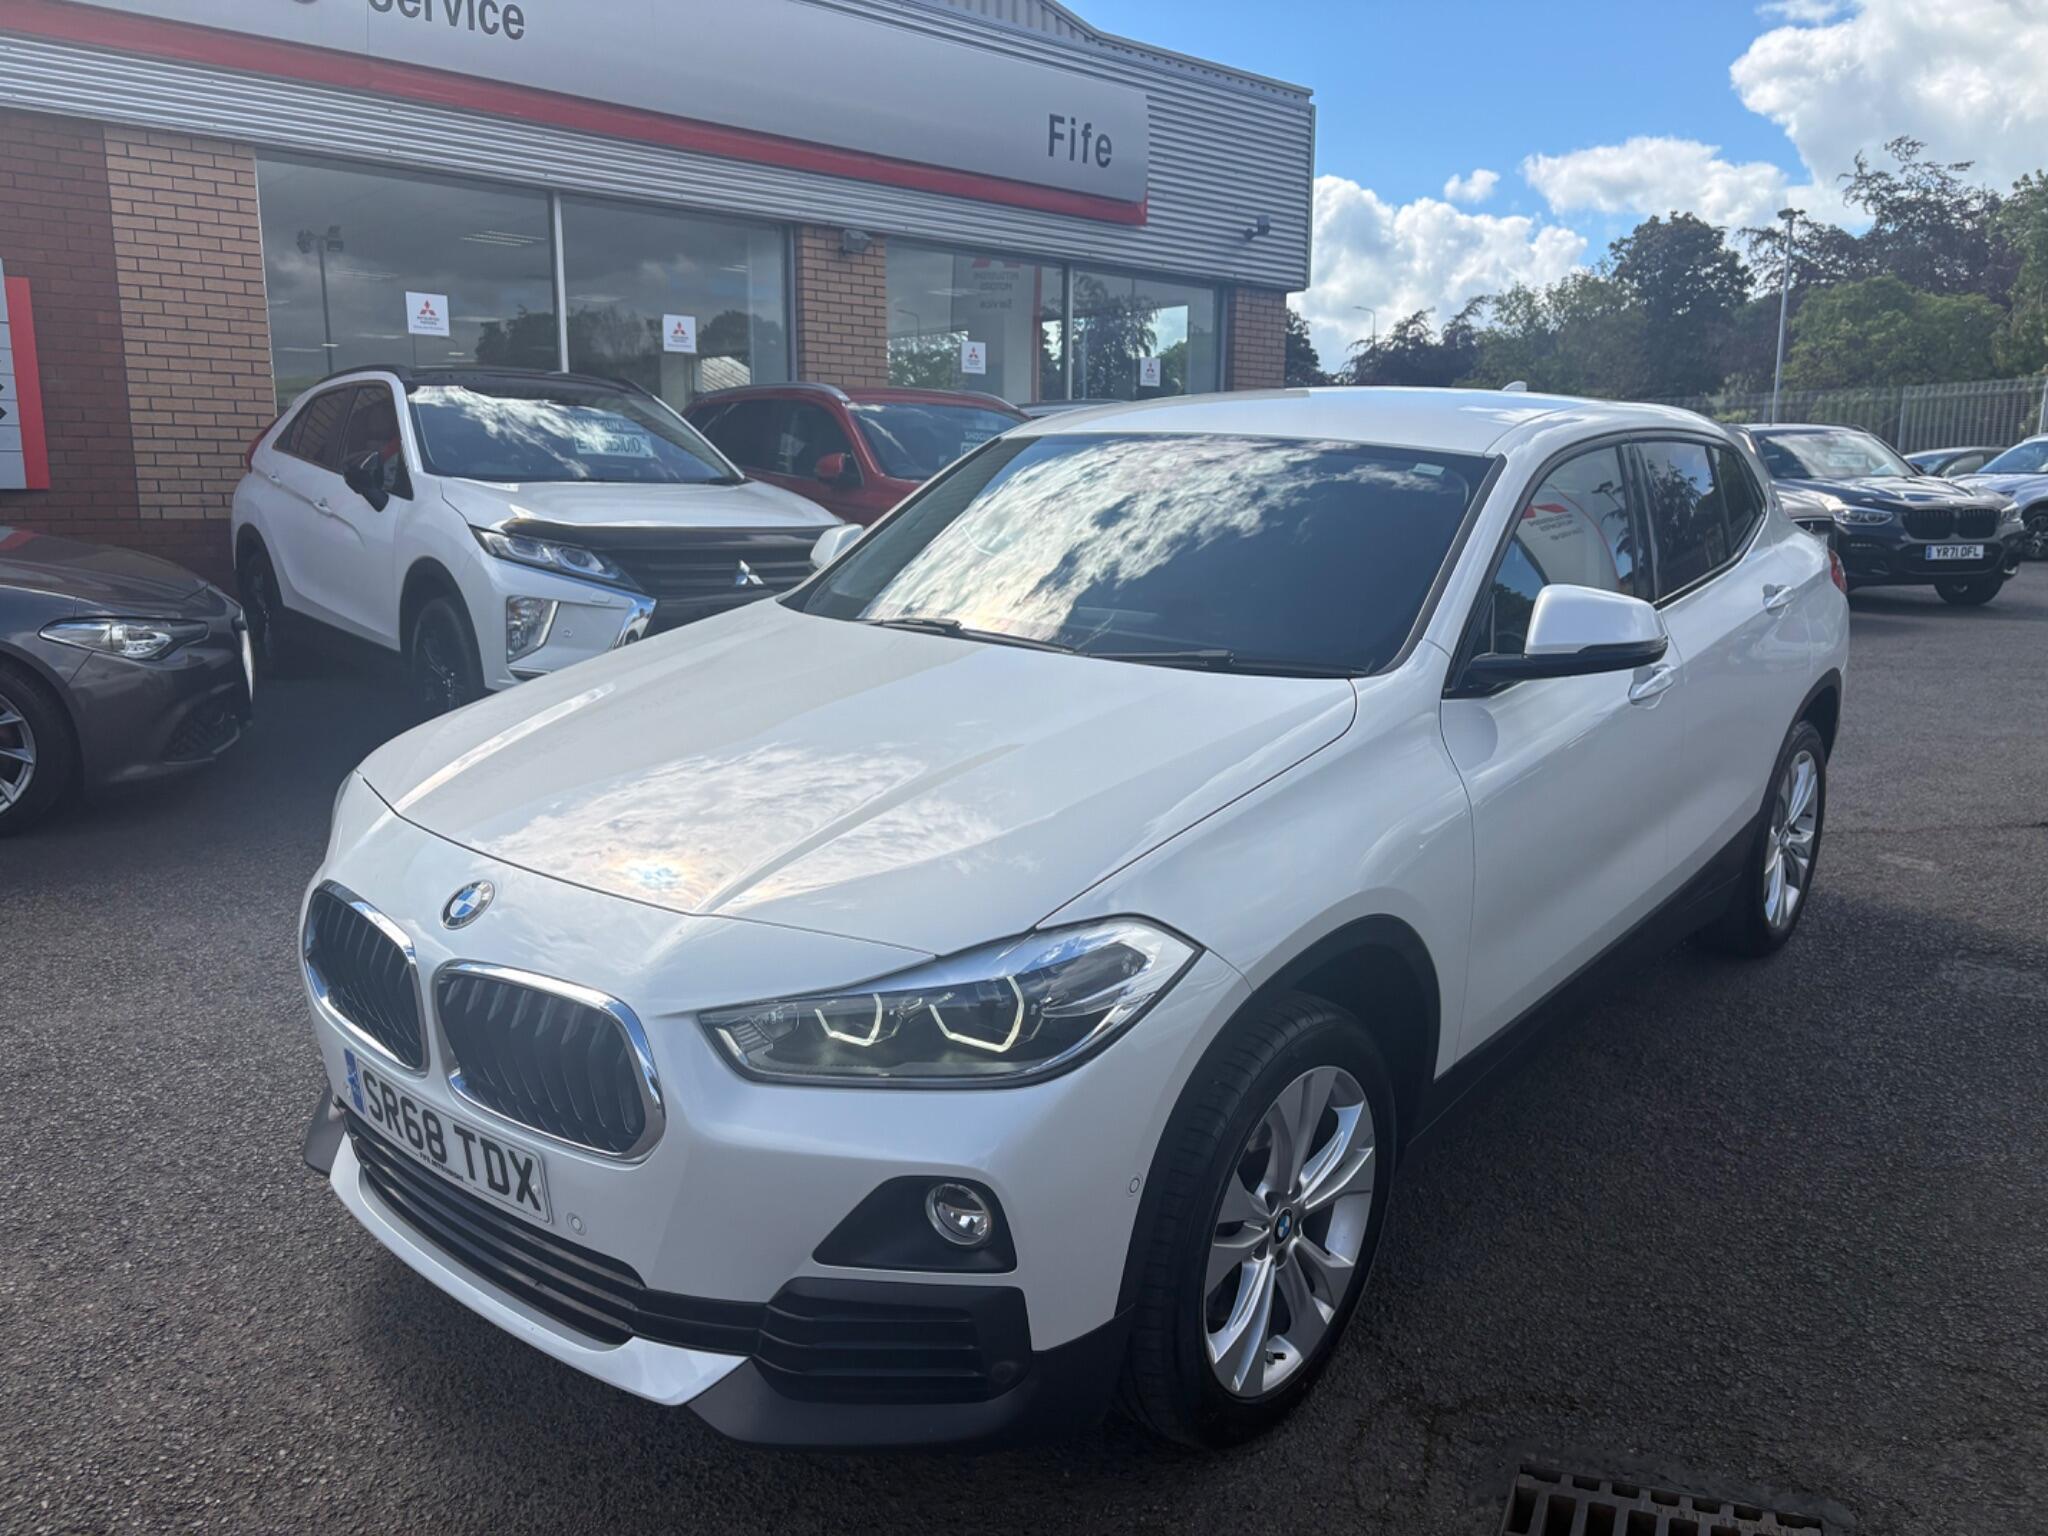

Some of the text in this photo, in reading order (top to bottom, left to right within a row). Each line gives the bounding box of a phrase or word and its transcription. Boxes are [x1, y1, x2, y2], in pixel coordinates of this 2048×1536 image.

[1048, 113, 1112, 168] Fife
[1936, 545, 1958, 557] YR71
[363, 1070, 541, 1212] SR68 TDX
